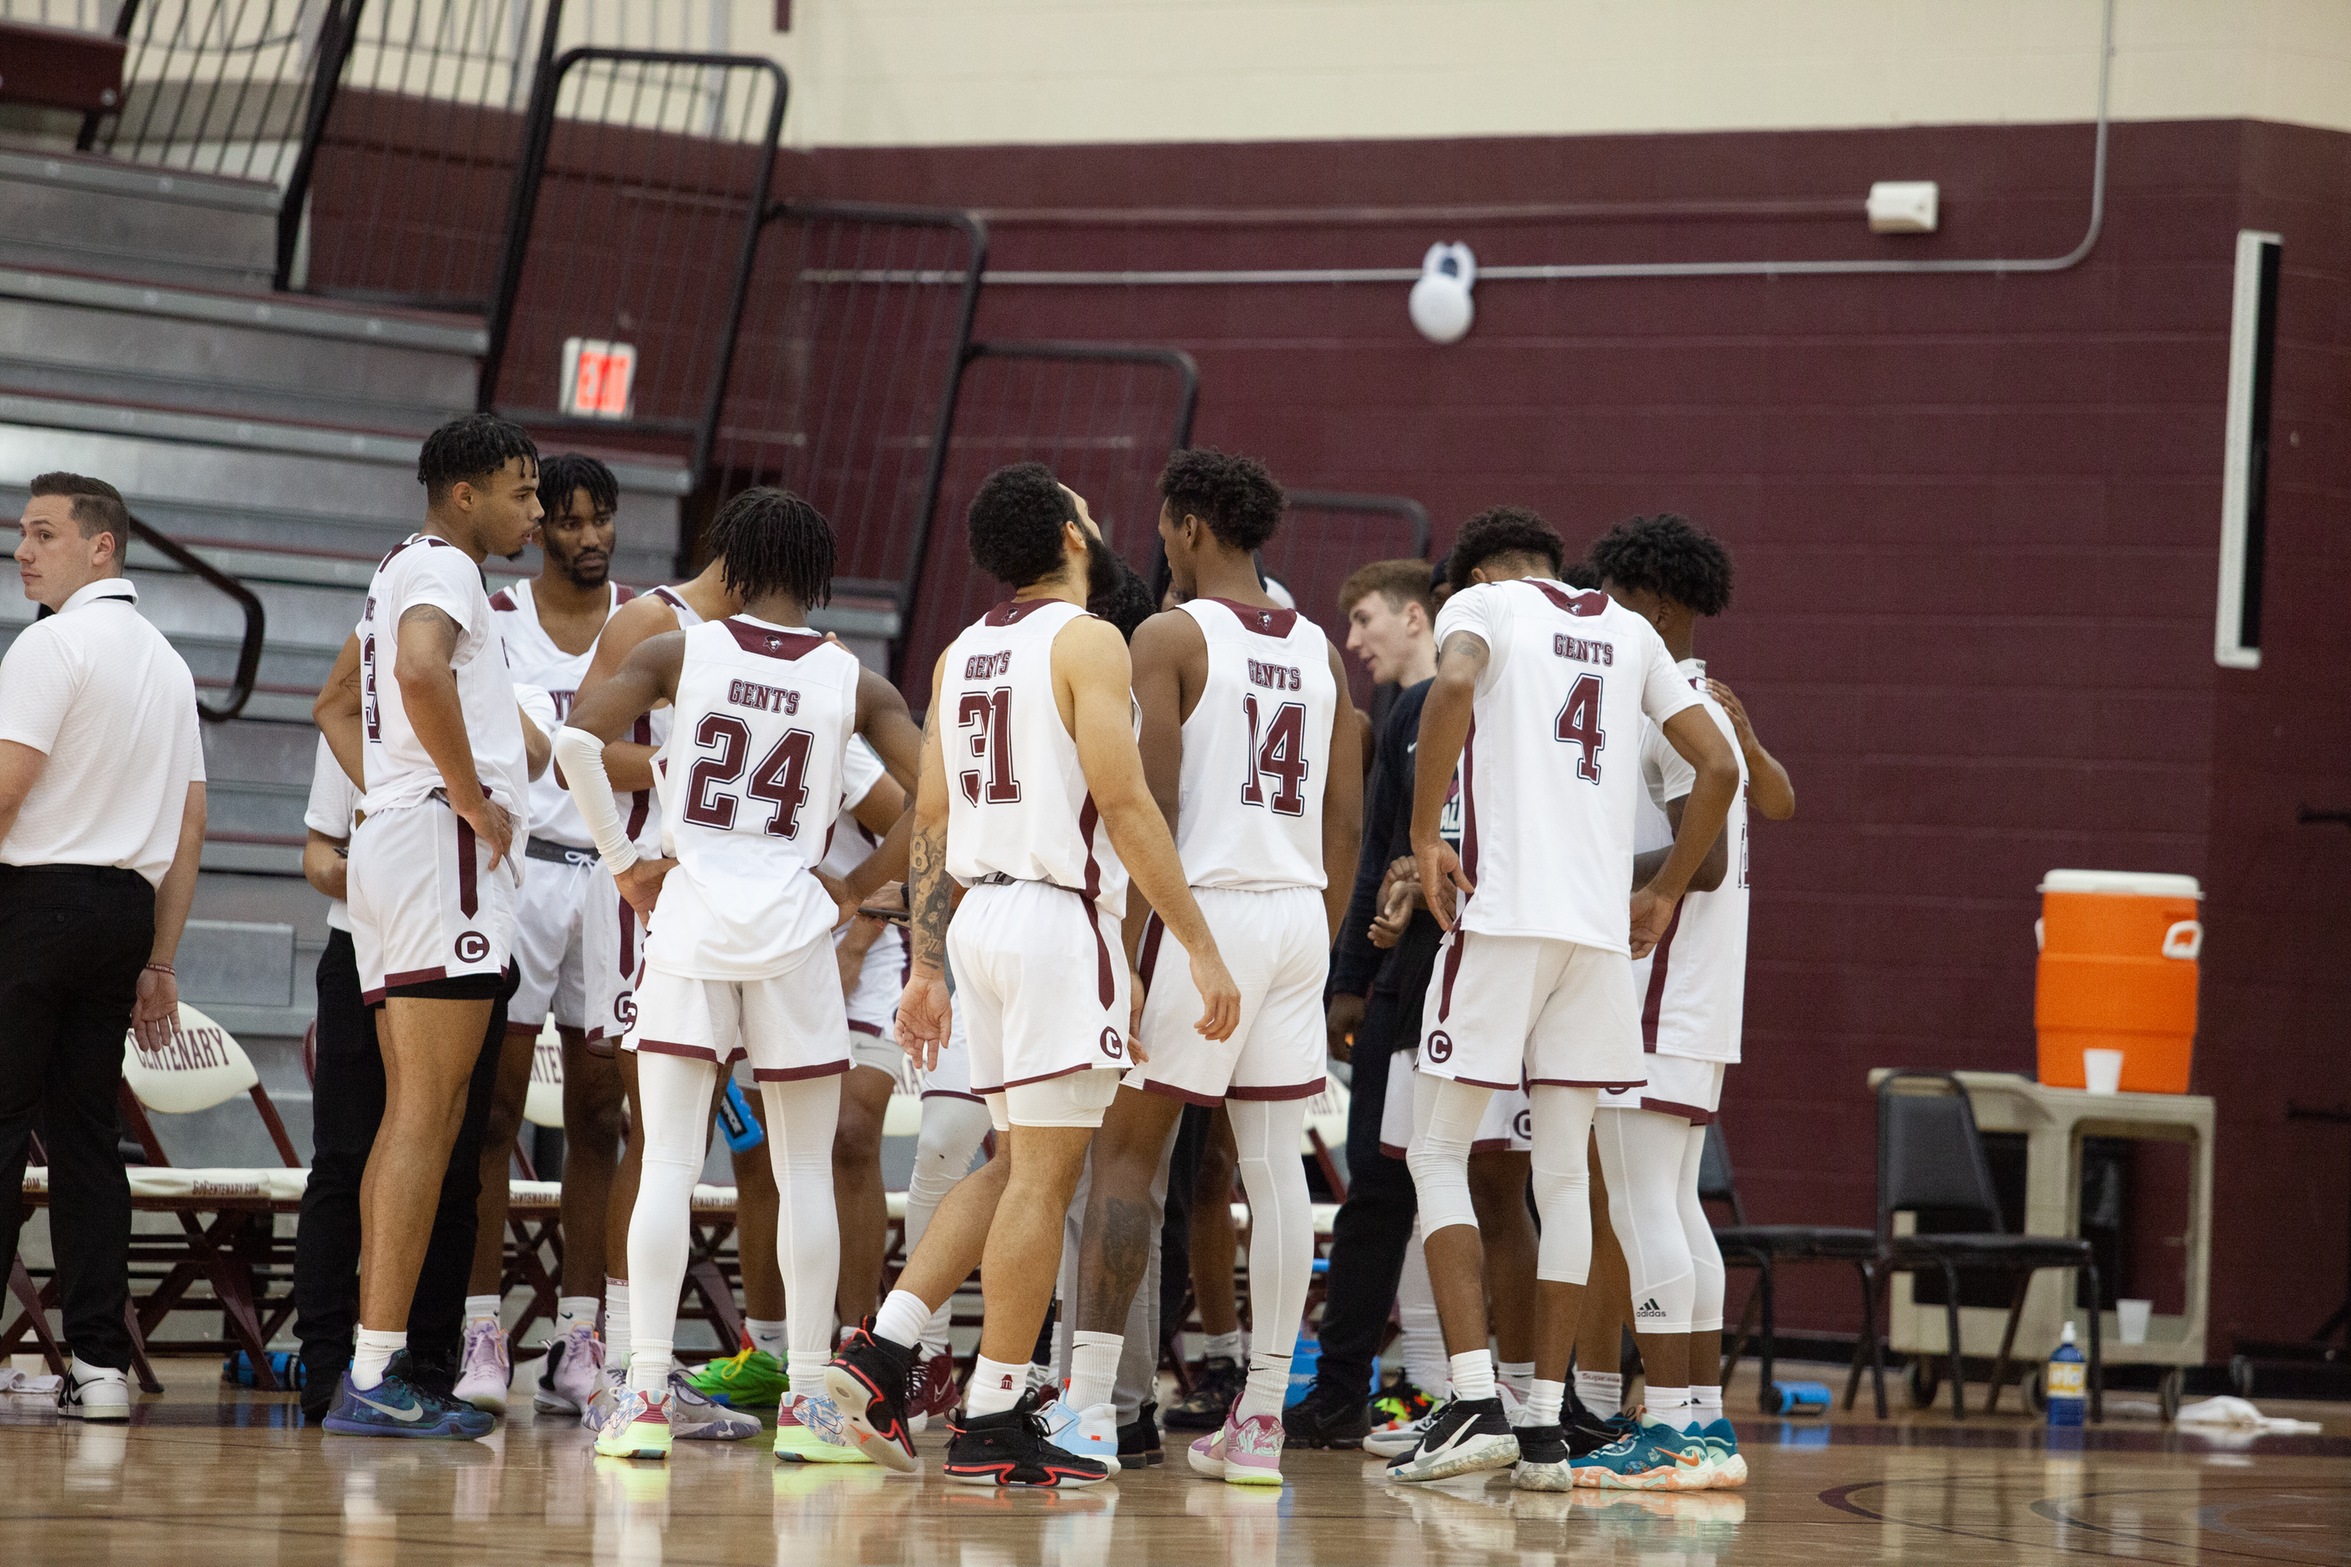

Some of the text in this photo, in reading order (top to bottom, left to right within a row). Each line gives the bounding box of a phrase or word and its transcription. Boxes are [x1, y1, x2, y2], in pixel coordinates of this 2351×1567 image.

[1553, 632, 1614, 667] GENTS
[1248, 658, 1302, 691] GENTS
[728, 678, 801, 716] GENTS
[958, 686, 1021, 808] 31
[1554, 672, 1606, 786] 4
[1241, 692, 1309, 817] 14
[683, 712, 815, 841] 24
[459, 934, 486, 961] C
[127, 1027, 230, 1071] CENARY
[1429, 1033, 1449, 1061] C
[1636, 1310, 1666, 1318] adidas
